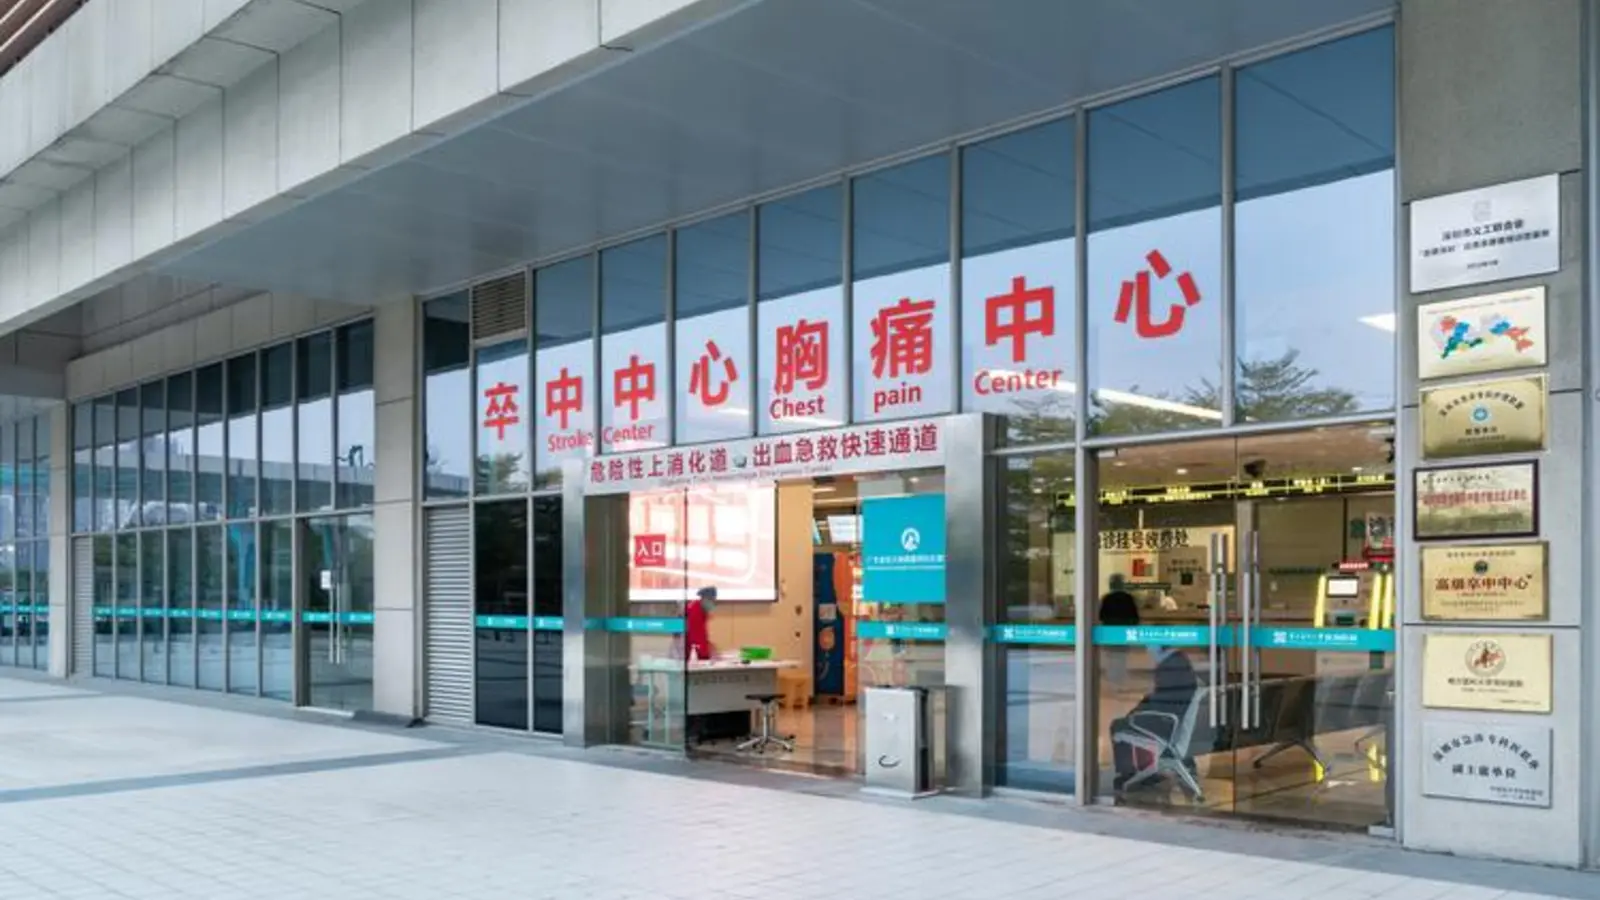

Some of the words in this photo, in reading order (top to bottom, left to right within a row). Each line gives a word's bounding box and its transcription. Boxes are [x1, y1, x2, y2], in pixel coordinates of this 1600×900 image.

[770, 395, 824, 421] Chest
[874, 381, 922, 413] pain
[974, 368, 1063, 395] Center
[603, 424, 655, 444] Center
[591, 447, 727, 483] 危险性上消化道
[753, 424, 938, 467] 出血急救快速通道
[637, 540, 663, 557] 入口
[1099, 528, 1189, 549] 诊挂号收费处
